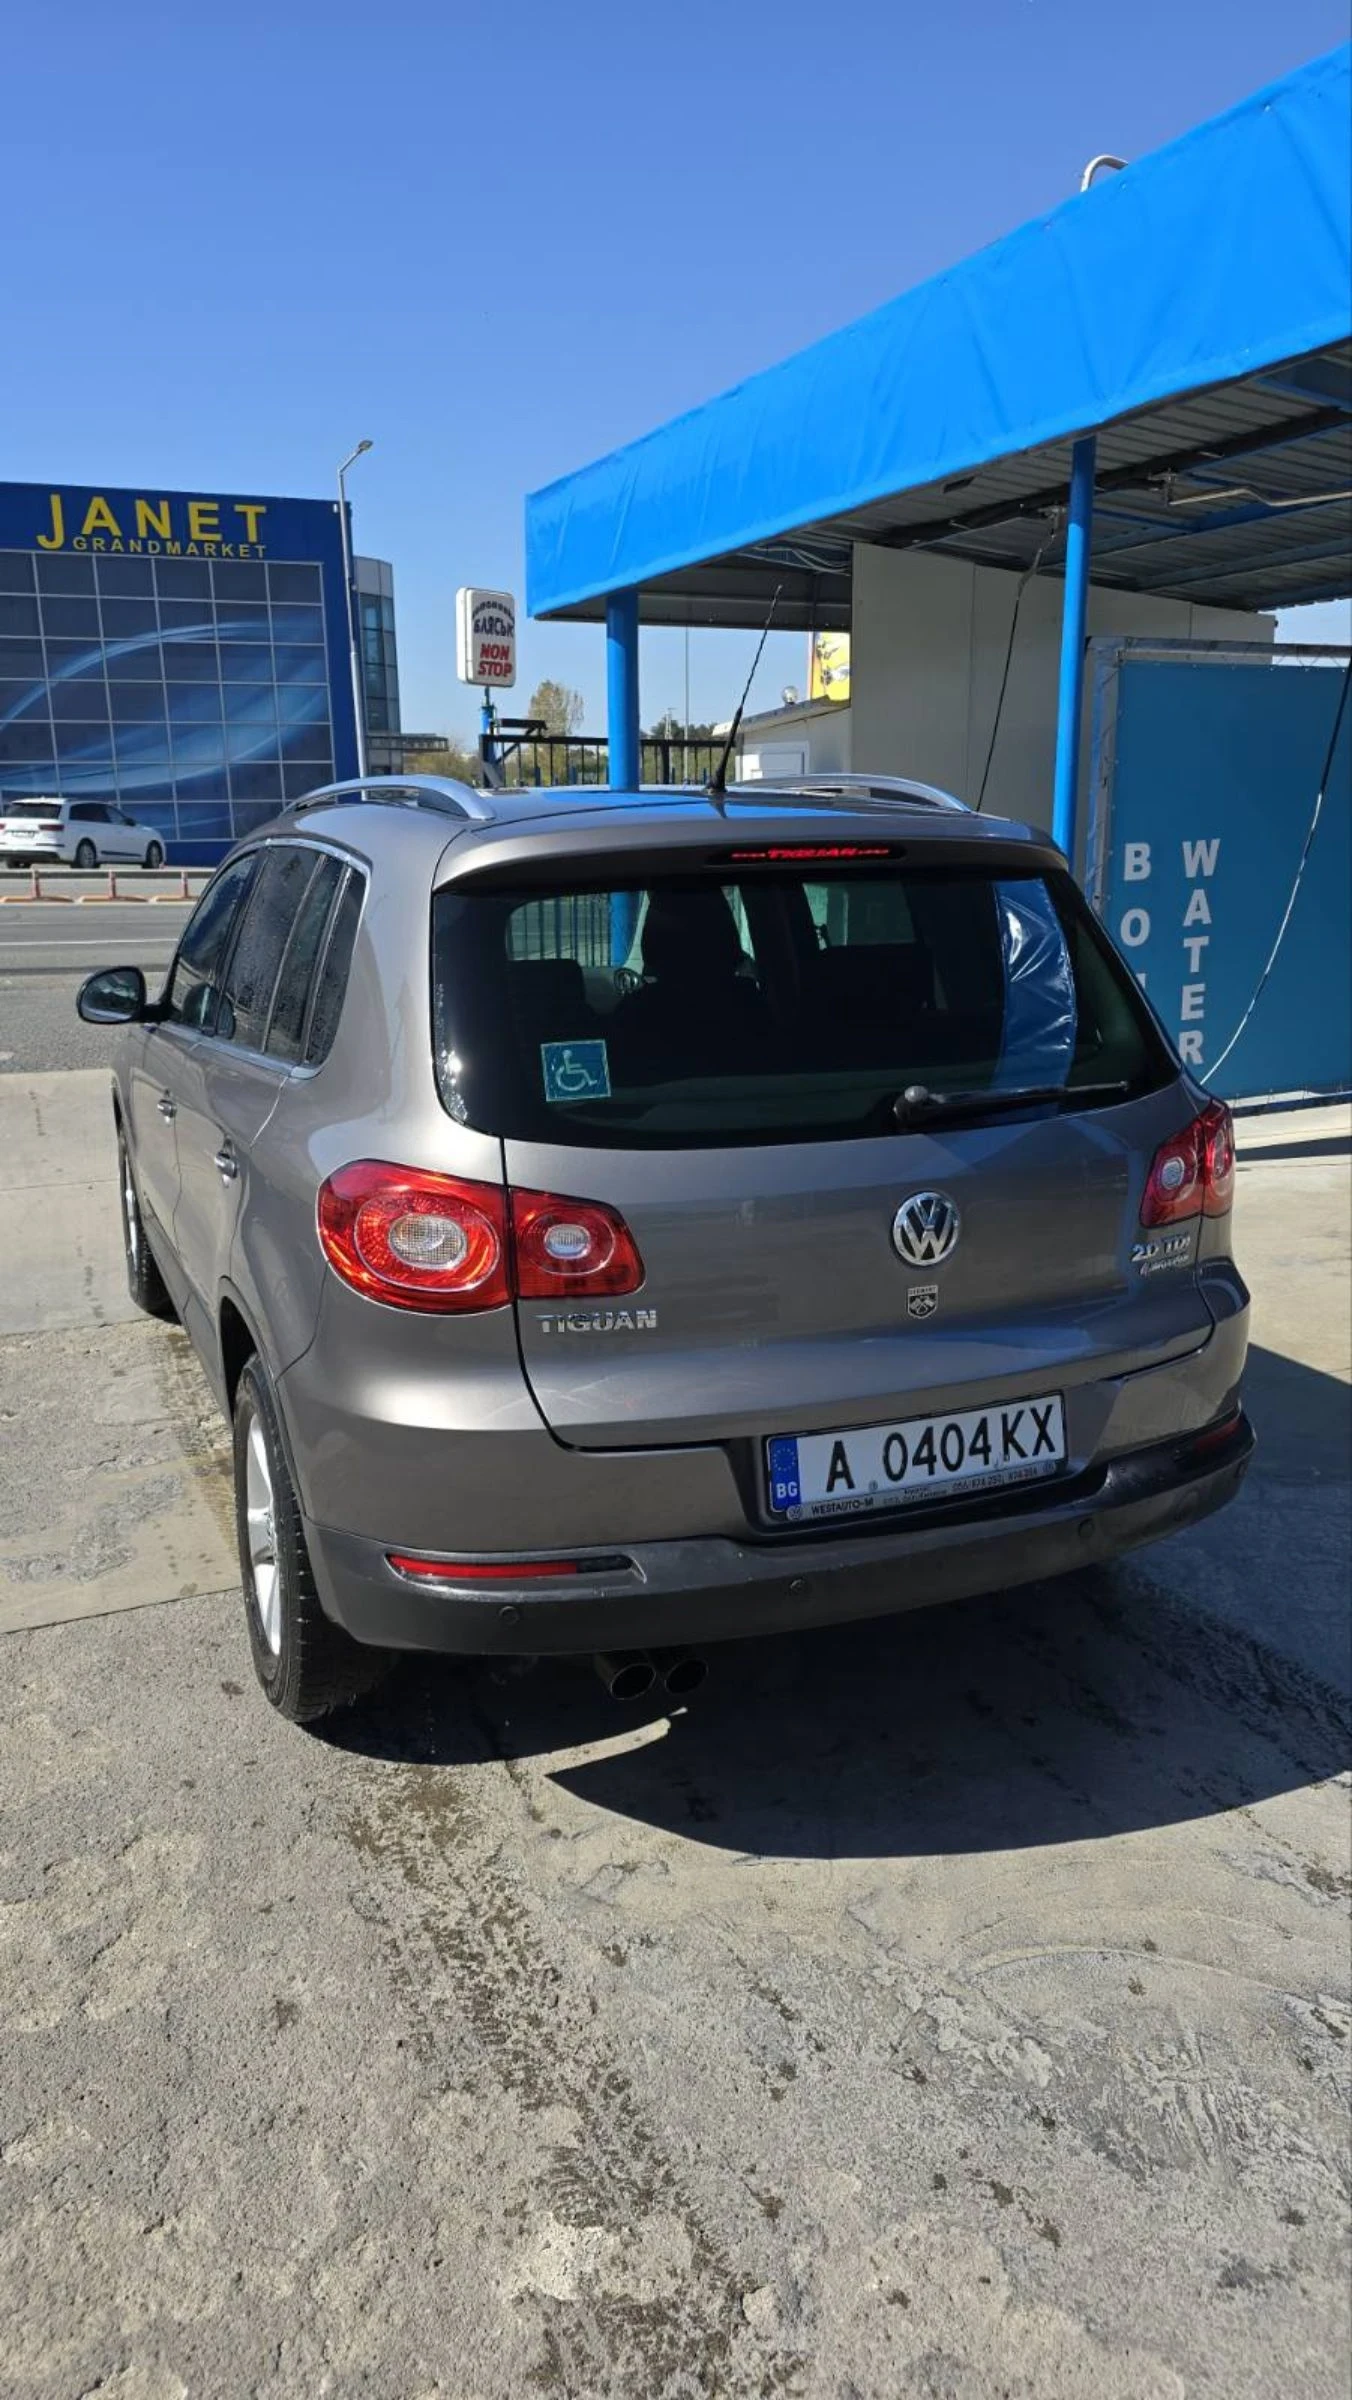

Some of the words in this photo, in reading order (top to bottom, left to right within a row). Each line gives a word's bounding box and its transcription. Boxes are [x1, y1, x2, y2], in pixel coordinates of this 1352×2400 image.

[36, 494, 267, 550] JANET
[73, 536, 267, 559] GRANDMARKET
[480, 643, 509, 661] NON
[478, 660, 513, 677] STOP
[1178, 838, 1221, 1065] WATER
[536, 1309, 657, 1333] TIGUAN
[825, 1440, 855, 1493] A
[776, 1480, 798, 1498] BG
